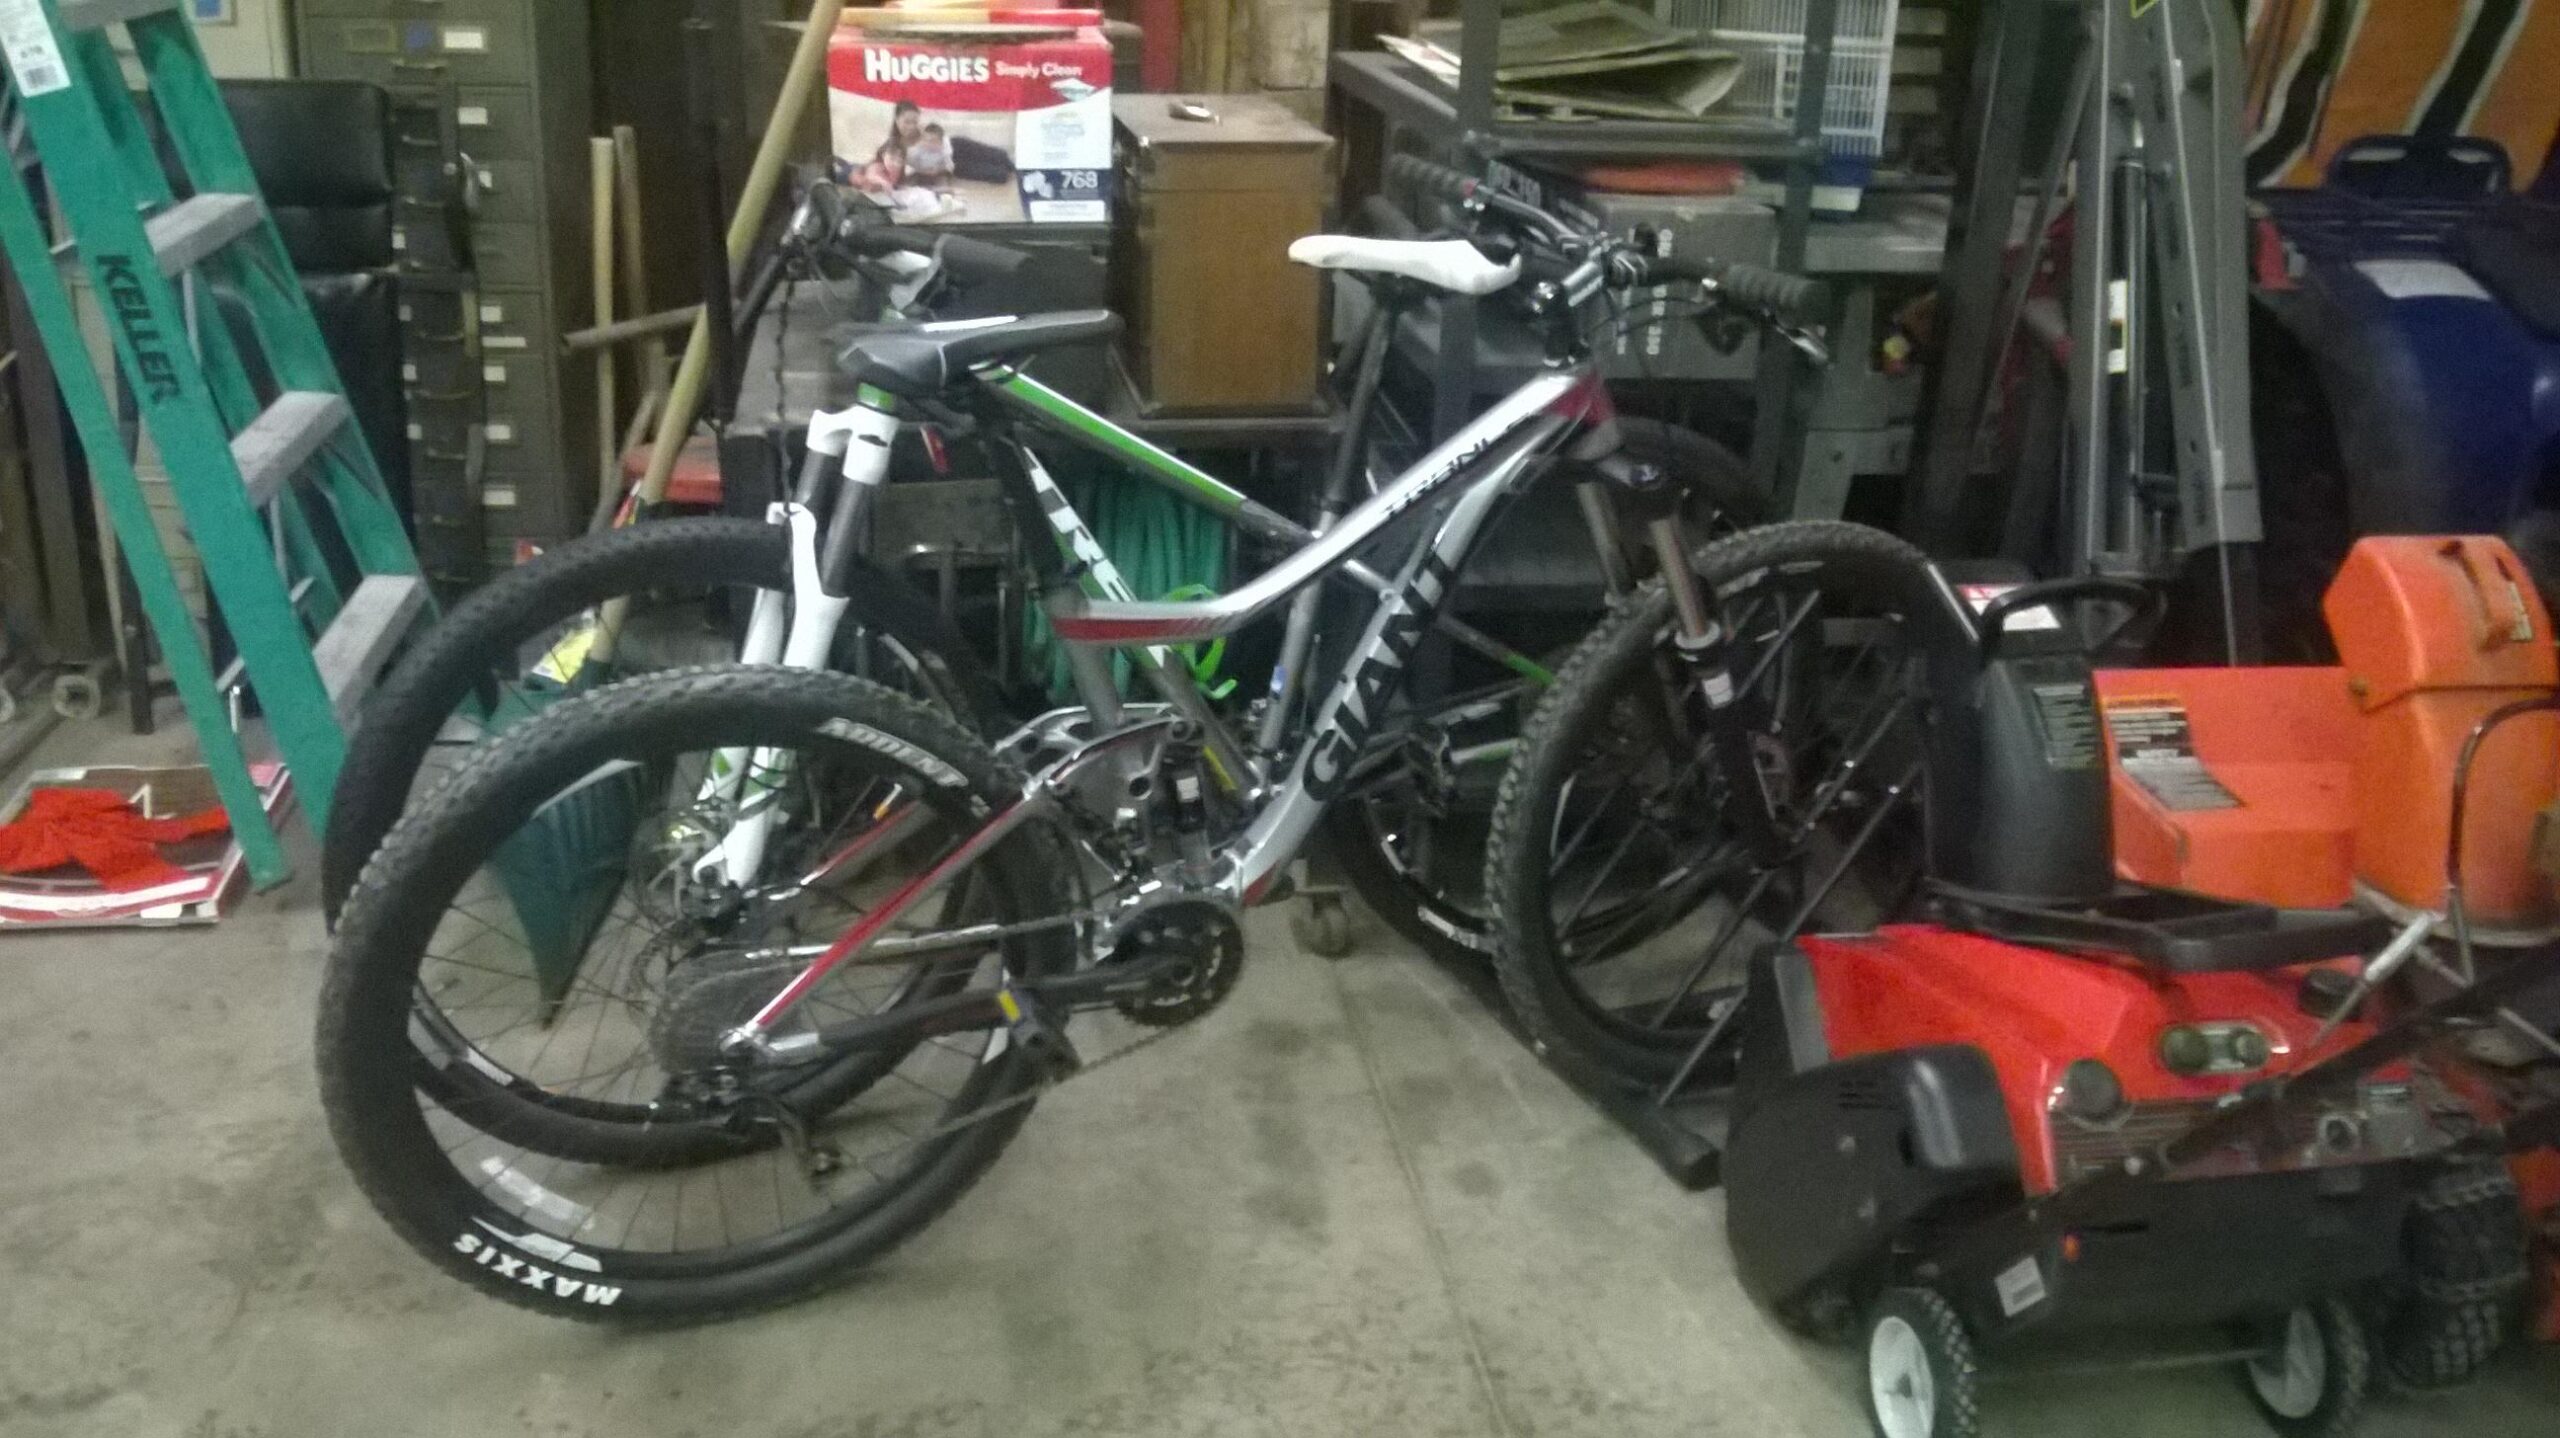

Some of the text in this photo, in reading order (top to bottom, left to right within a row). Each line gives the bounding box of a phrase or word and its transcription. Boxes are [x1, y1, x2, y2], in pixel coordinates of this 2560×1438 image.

[864, 48, 1083, 83] HUGGIES Simply Clean
[1060, 170, 1099, 189] 768
[96, 254, 182, 405] KELLER
[1302, 546, 1454, 802] GIANT
[453, 1233, 622, 1305] MAXXIS
